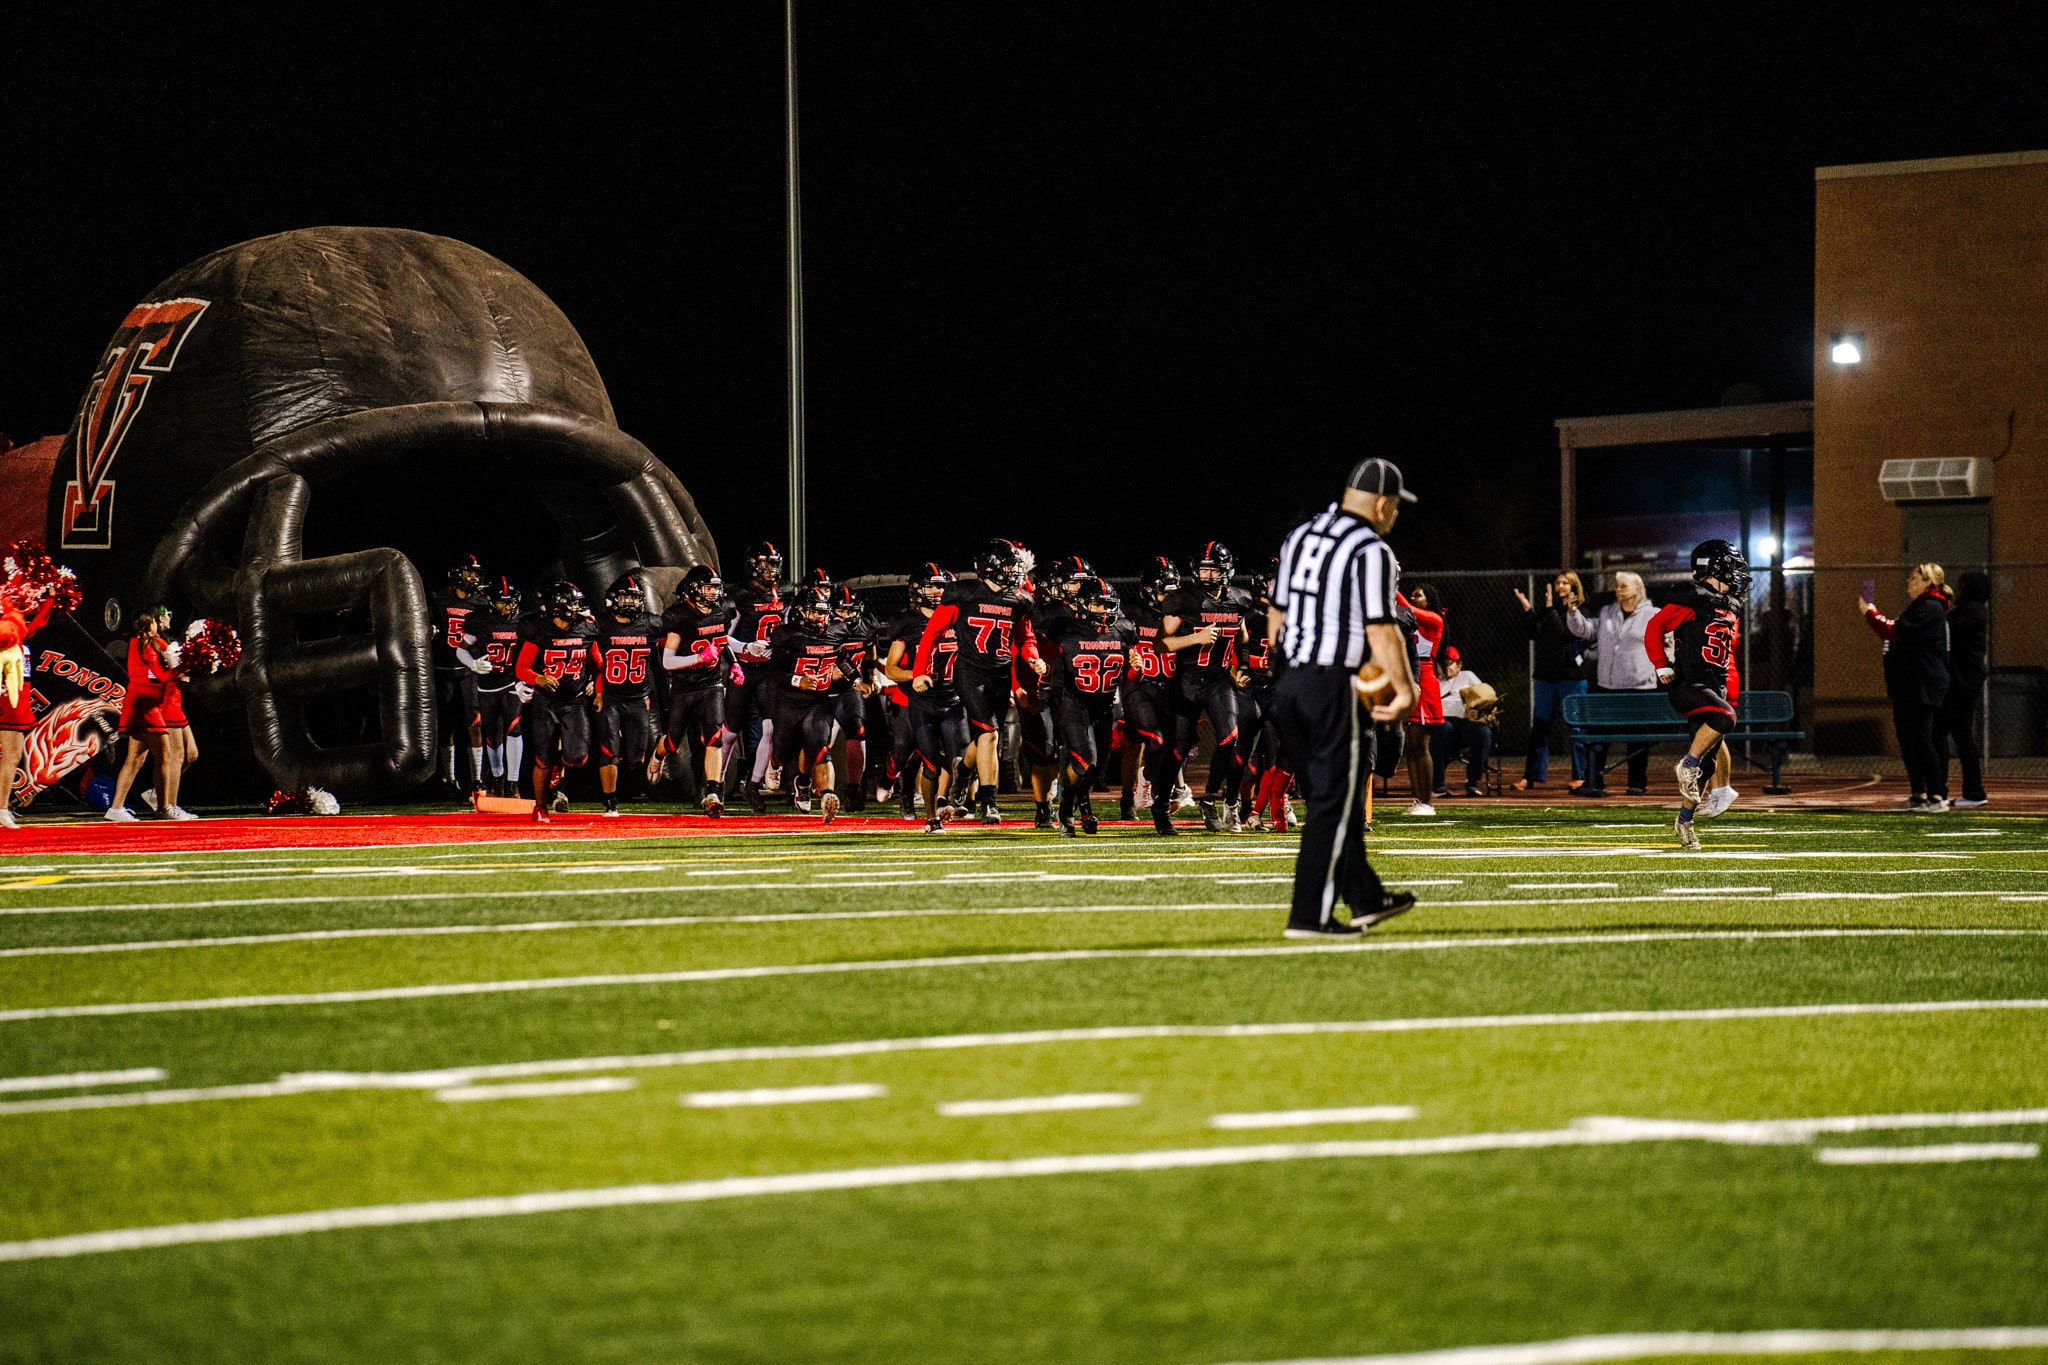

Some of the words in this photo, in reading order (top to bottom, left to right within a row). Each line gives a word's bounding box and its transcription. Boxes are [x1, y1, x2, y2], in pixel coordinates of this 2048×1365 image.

[967, 616, 1013, 657] 71
[1078, 640, 1122, 651] TONOPAH
[605, 648, 652, 685] 65
[1072, 653, 1125, 693] 32
